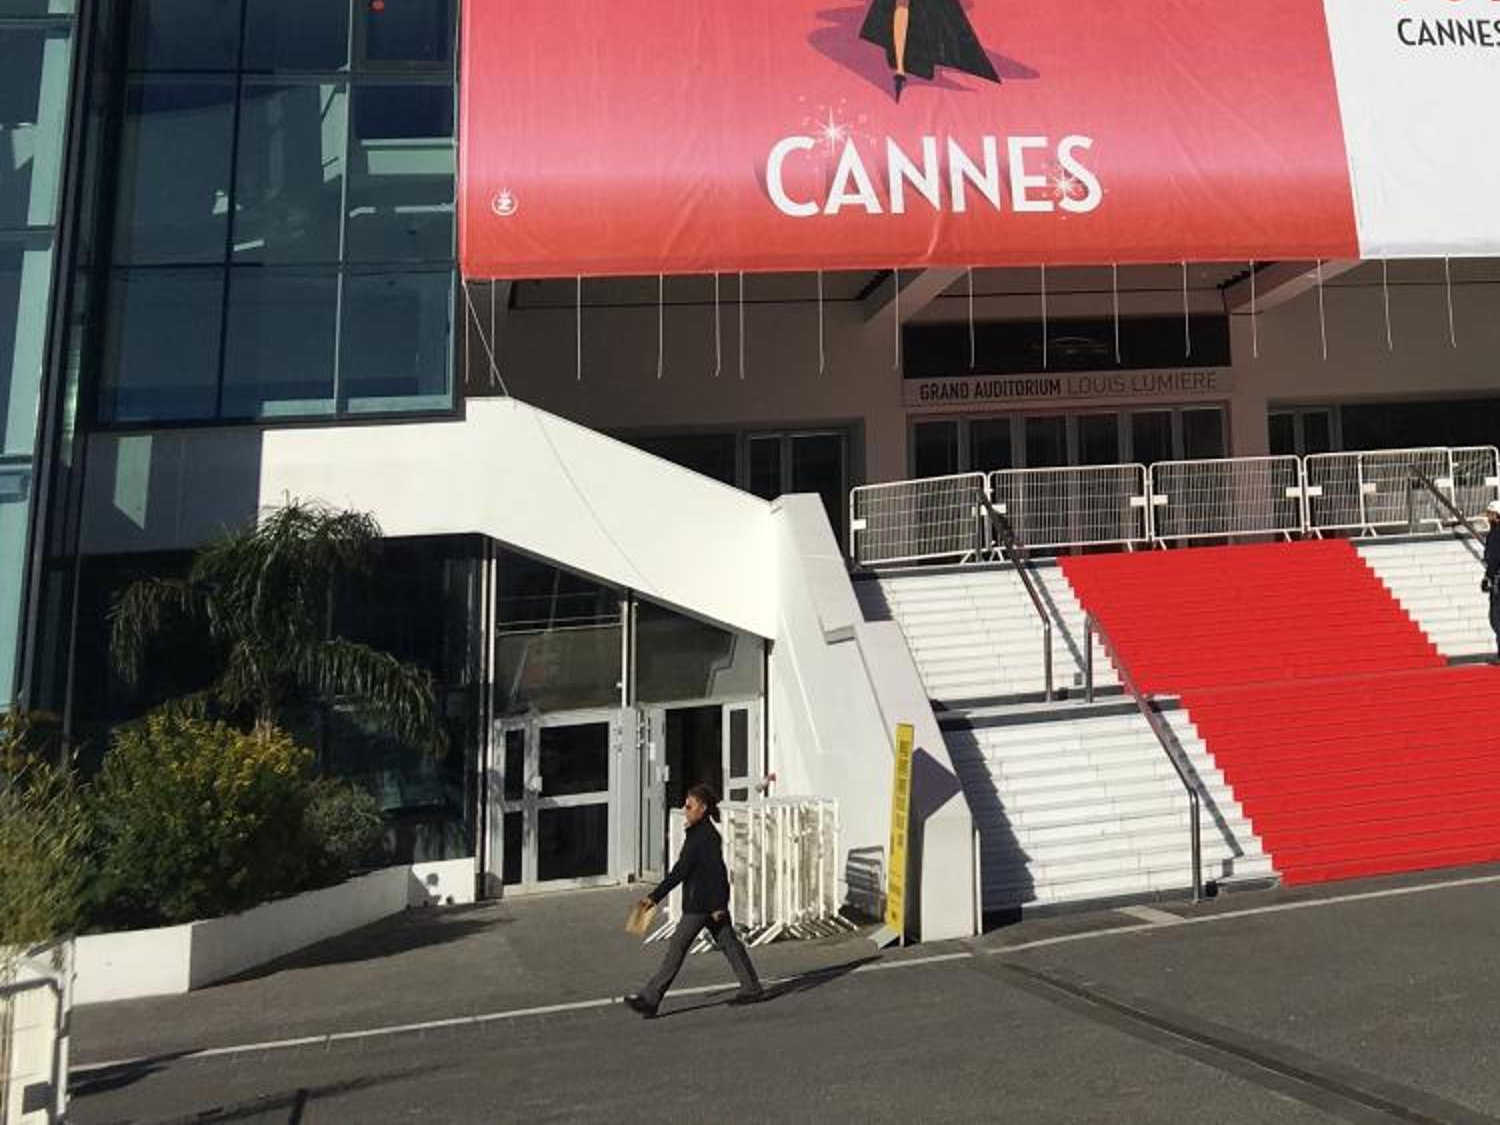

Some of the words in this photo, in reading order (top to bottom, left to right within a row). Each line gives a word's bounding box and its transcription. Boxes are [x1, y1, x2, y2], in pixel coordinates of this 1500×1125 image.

[765, 134, 1104, 218] CANNES
[919, 382, 969, 401] GRAND
[974, 377, 1061, 399] AUDITORIUM
[1066, 375, 1125, 395] LOUIS
